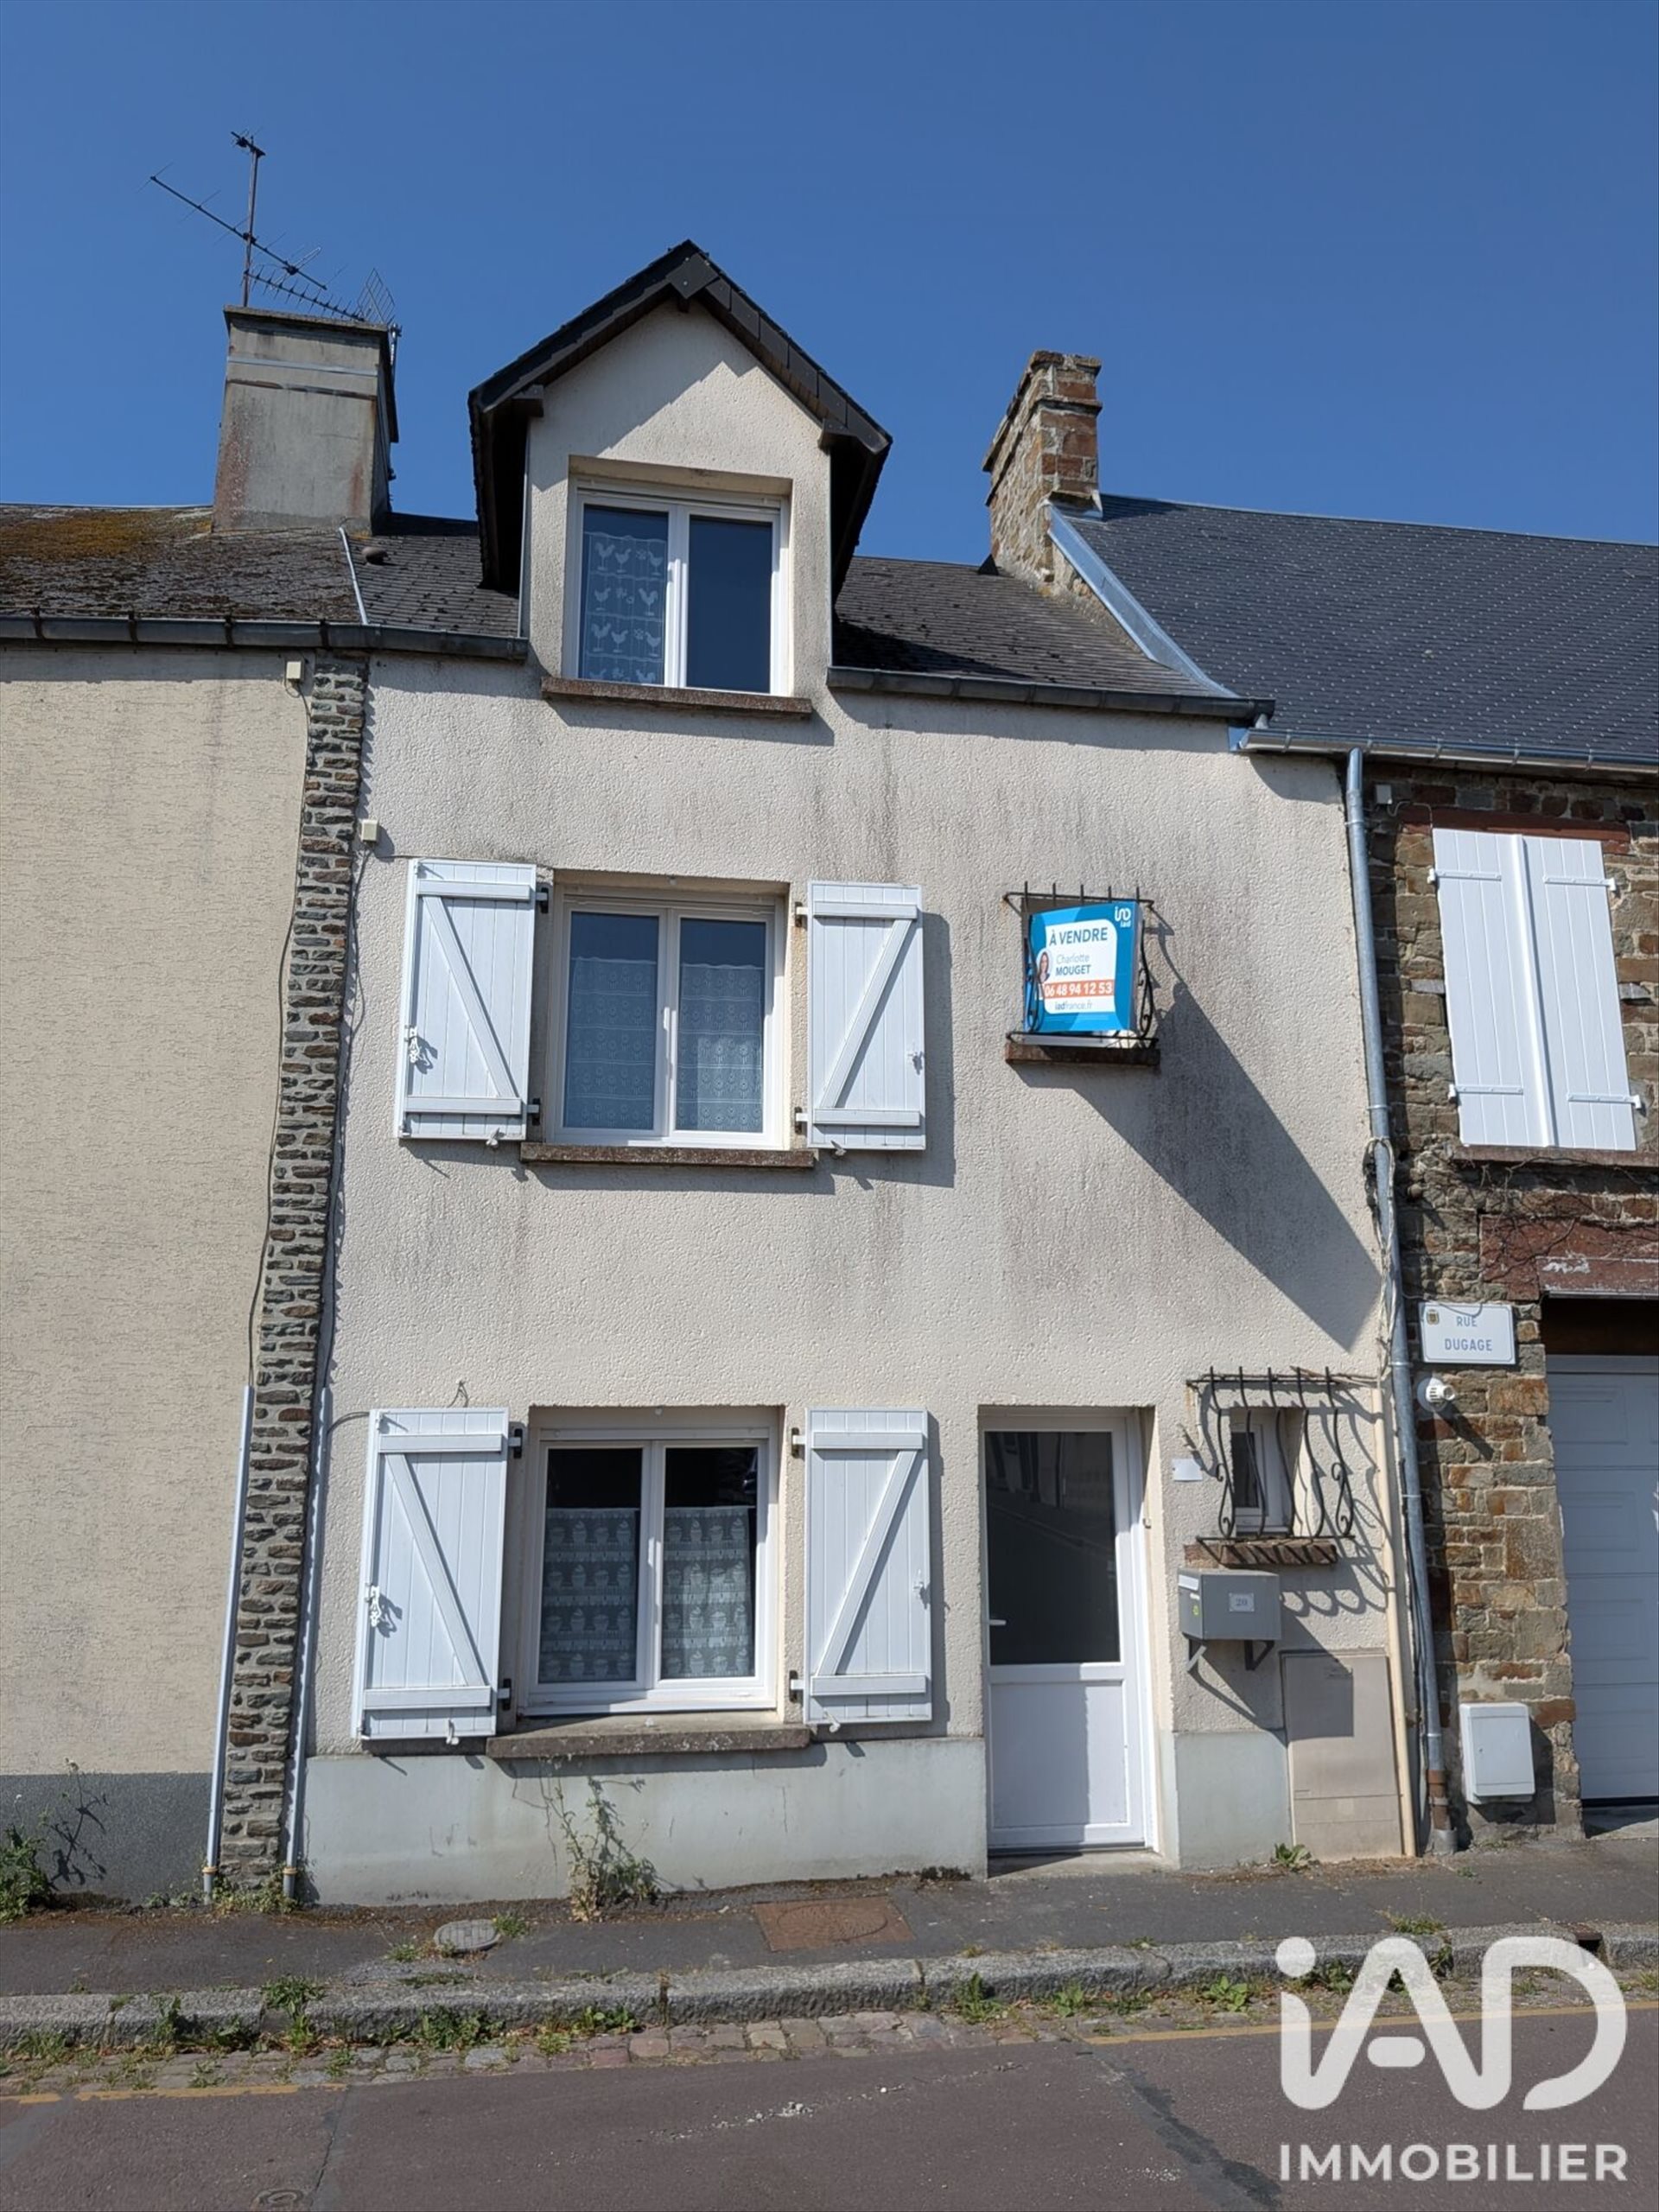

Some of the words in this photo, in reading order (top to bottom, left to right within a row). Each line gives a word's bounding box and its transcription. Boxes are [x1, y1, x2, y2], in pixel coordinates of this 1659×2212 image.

[1049, 928, 1057, 946] À
[1059, 927, 1108, 944] VENDRE
[1056, 953, 1090, 965] Charlotte
[1056, 965, 1090, 976] MOUGET
[1045, 985, 1055, 996] 06
[1056, 984, 1067, 995] 48
[1069, 983, 1081, 995] 94
[1084, 982, 1096, 995] 12
[1098, 982, 1112, 994] 53
[1055, 1000, 1092, 1011] iadfrance.fr
[1456, 1316, 1478, 1327] RUE
[1444, 1338, 1493, 1351] DUGAGE
